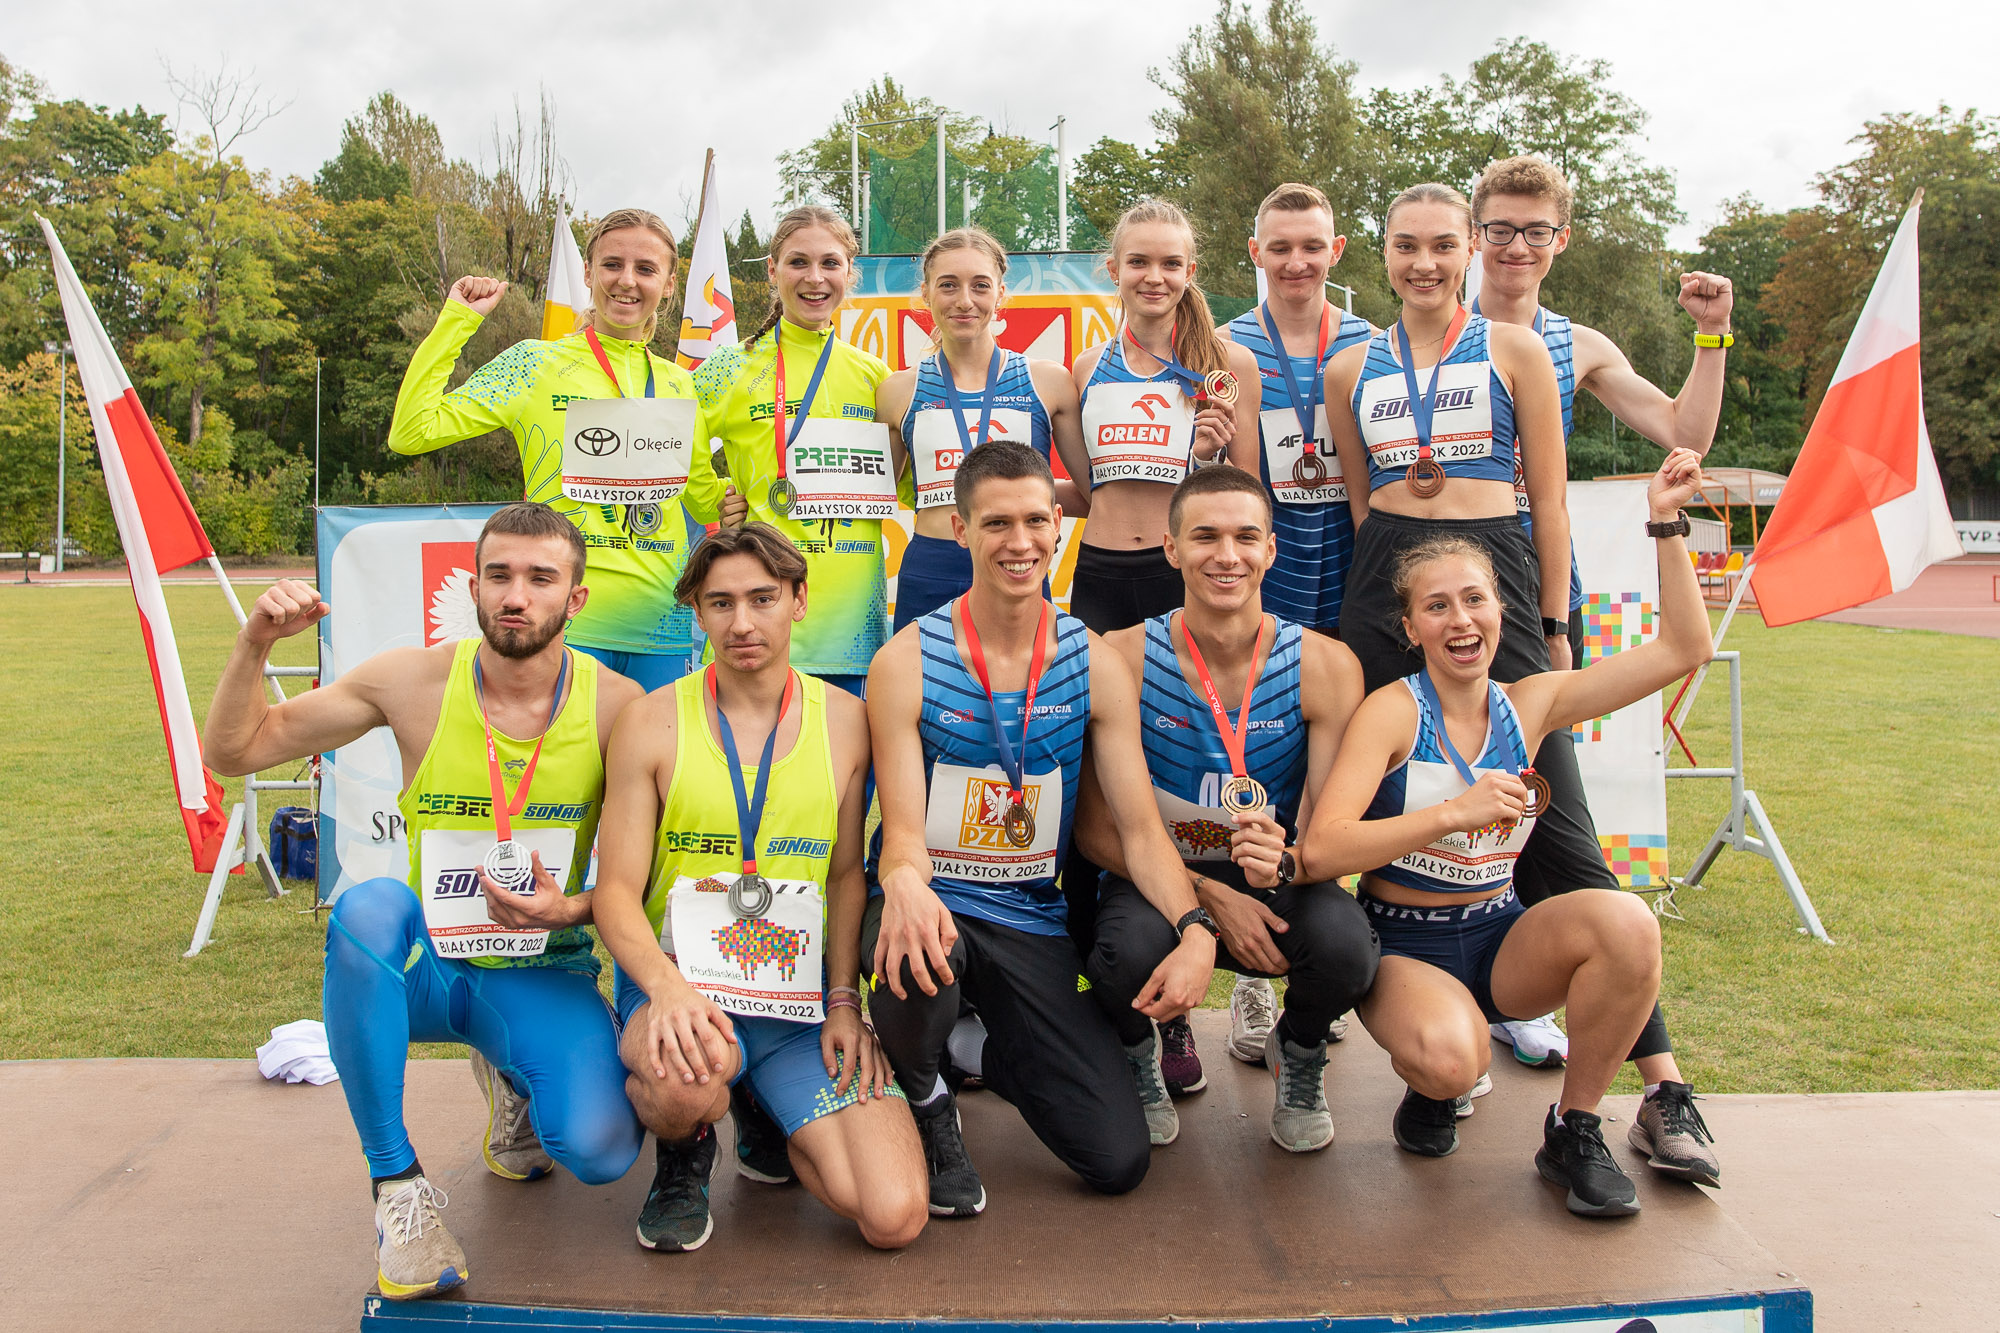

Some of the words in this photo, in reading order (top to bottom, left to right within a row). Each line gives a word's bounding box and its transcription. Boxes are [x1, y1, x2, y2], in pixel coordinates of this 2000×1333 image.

[1100, 426, 1166, 443] ORLEN
[1277, 433, 1302, 448] 4F
[1452, 432, 1489, 440] SZTAFETACH
[634, 437, 682, 452] Okęcie
[1451, 443, 1485, 457] 2022
[1144, 465, 1178, 480] 2022
[570, 488, 646, 501] BIAŁYSTOK
[650, 487, 679, 500] 2022
[923, 490, 955, 505] BIAŁY
[1281, 487, 1346, 501] BIAŁYSTOK
[795, 504, 863, 515] BIAŁYSTOK
[865, 504, 894, 515] 2022
[1957, 530, 1992, 542] TVP
[834, 541, 877, 554] SONAROL
[1016, 704, 1073, 715] KNDYCJA
[1211, 693, 1223, 715] PZLA
[1436, 837, 1466, 849] askie
[943, 851, 990, 862] MISTRZOSTWA
[1020, 851, 1054, 862] SZTAFETACH
[1015, 862, 1048, 878] 2022
[1402, 854, 1482, 880] BIAŁYSTOK
[1485, 862, 1508, 879] 2022
[446, 926, 493, 935] MISTRZOSTWA
[439, 938, 516, 954] BIAŁYSTOK
[518, 937, 544, 952] 2022
[690, 965, 742, 980] Podlaskie
[706, 983, 750, 996] MISTRZOSTWA
[750, 990, 771, 998] POLSKI
[779, 1004, 816, 1018] 2022
